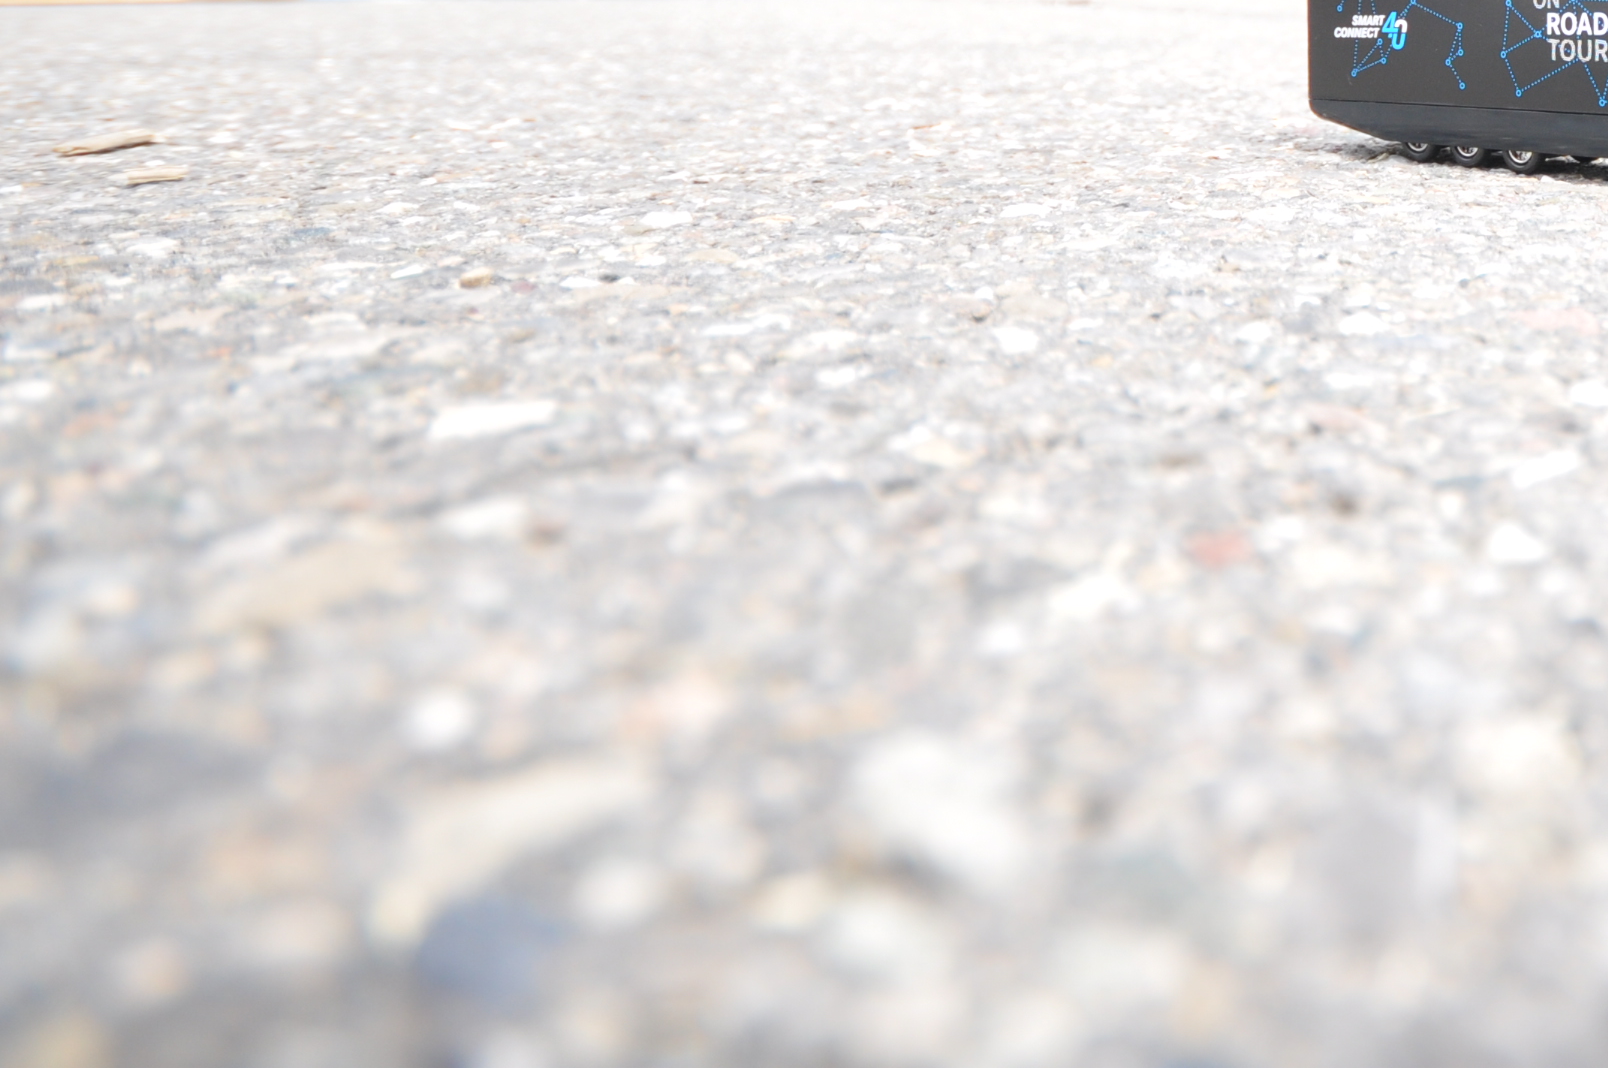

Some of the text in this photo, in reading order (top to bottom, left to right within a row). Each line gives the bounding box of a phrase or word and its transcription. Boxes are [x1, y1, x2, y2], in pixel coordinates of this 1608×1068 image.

[1352, 15, 1385, 26] SMART
[1546, 12, 1608, 36] ROAD
[1334, 27, 1380, 38] CONNECT
[1547, 38, 1608, 63] TOUR
